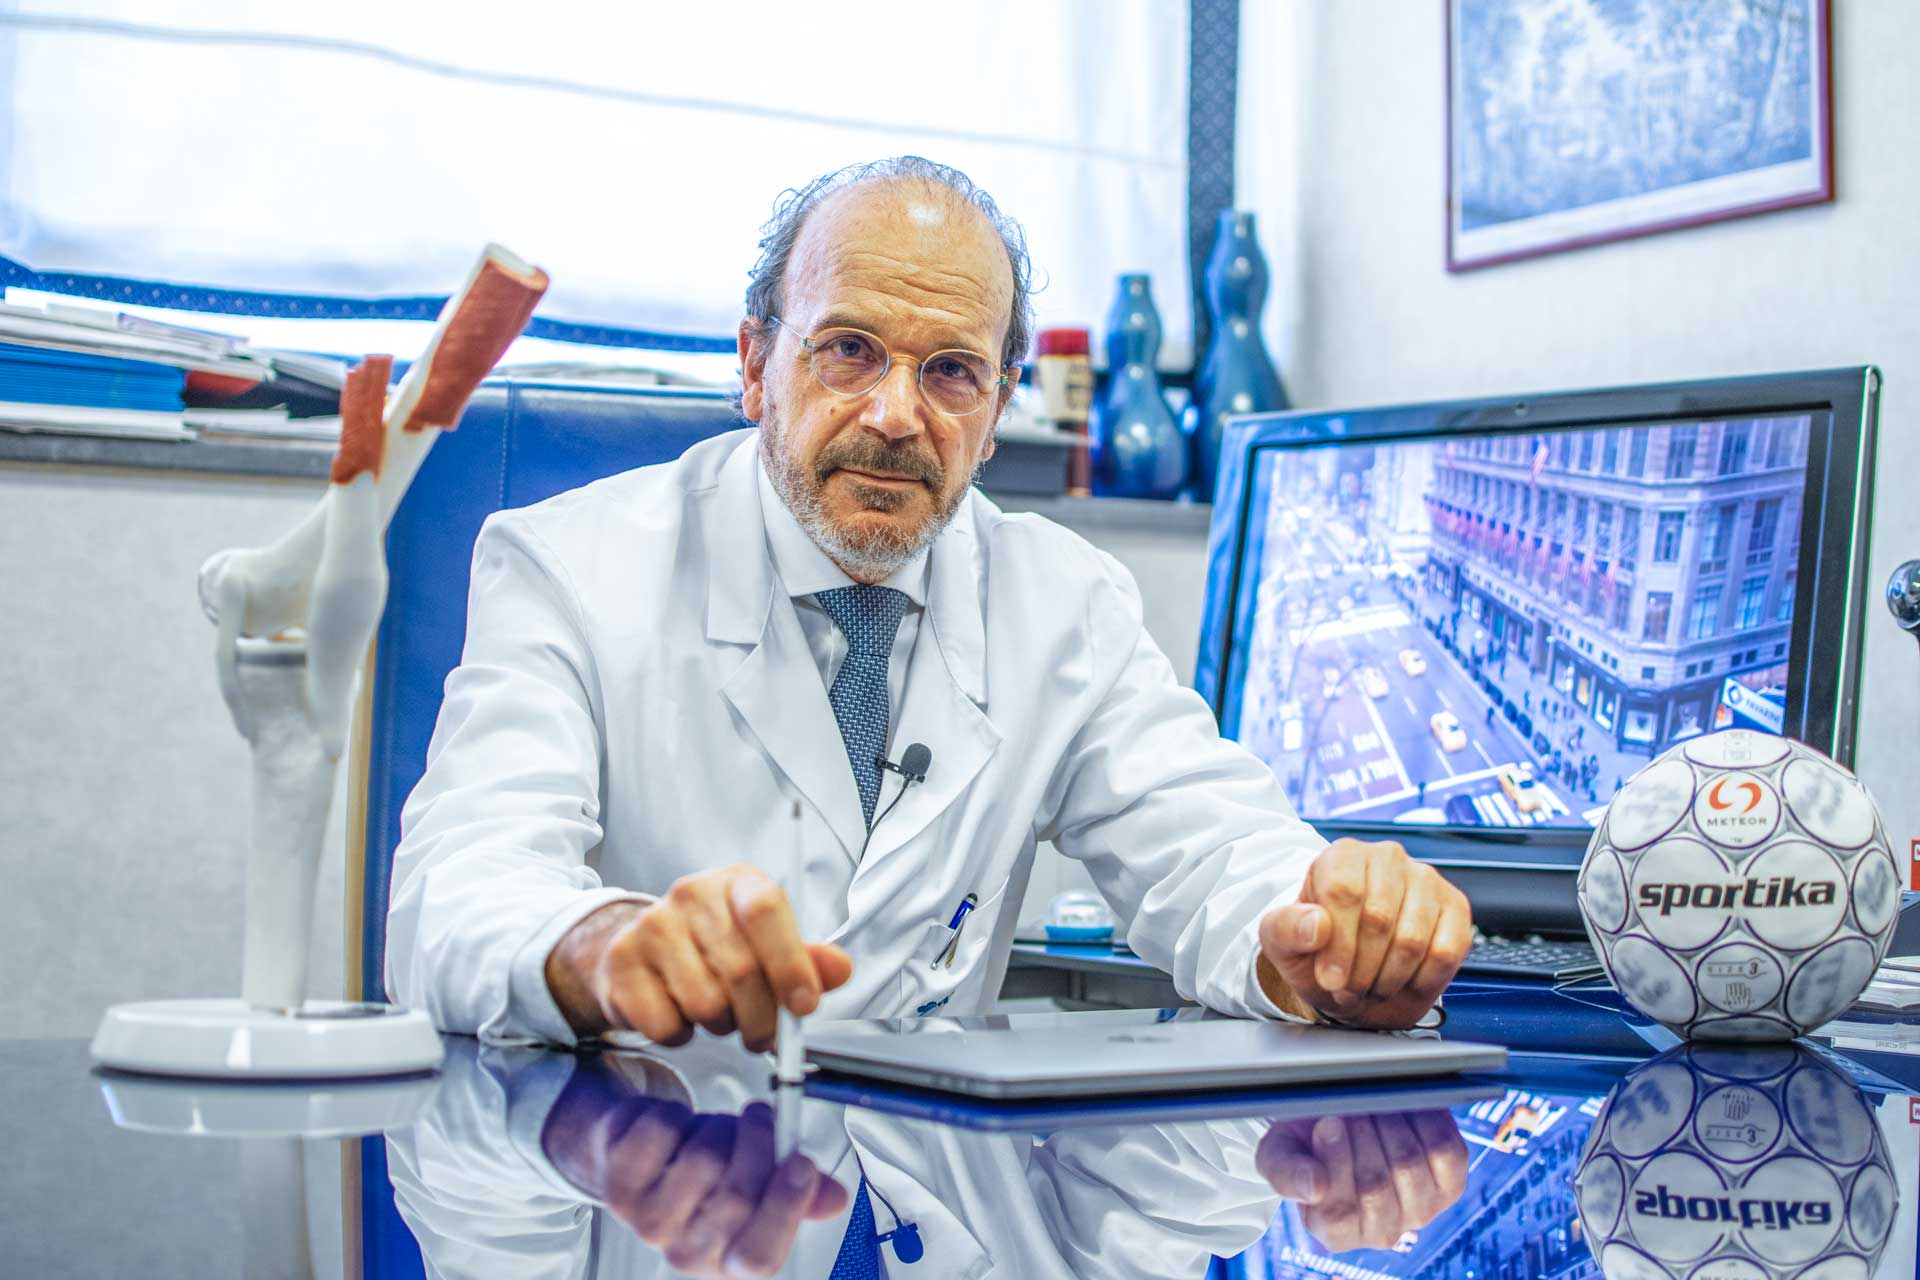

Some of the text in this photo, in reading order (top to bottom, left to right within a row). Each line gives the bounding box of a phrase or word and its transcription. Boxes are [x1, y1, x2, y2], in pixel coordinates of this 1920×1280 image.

[1706, 816, 1767, 827] METEOR
[1639, 876, 1836, 916] sportika
[1749, 961, 1759, 976] 3
